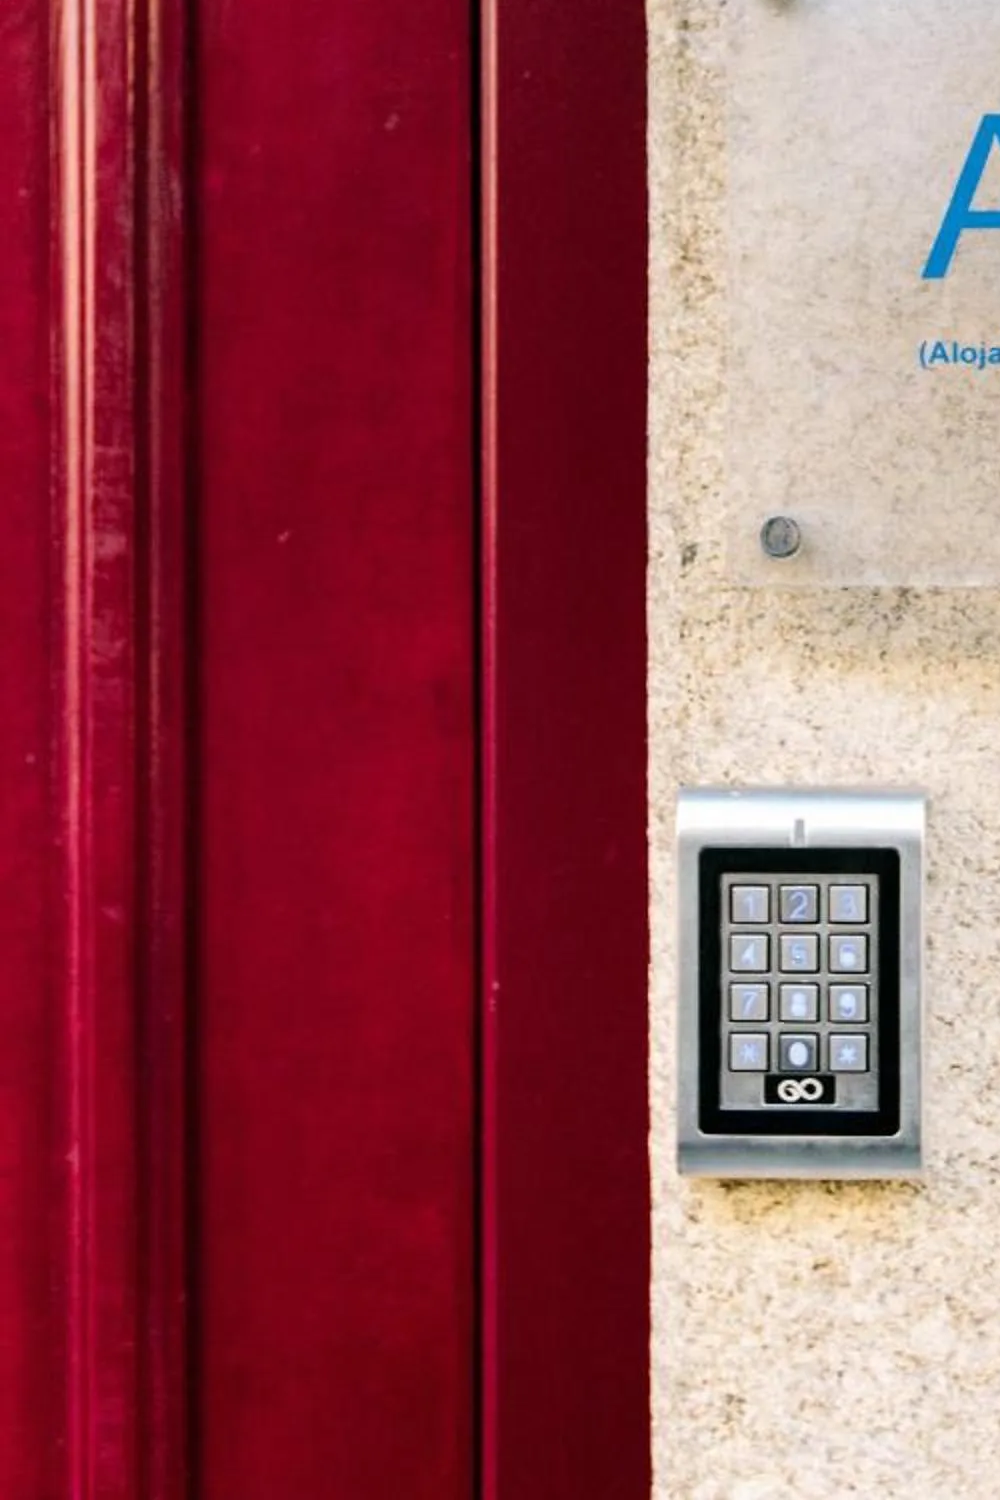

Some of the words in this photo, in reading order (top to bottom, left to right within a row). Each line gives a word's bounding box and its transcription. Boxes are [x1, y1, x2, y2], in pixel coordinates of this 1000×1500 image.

[789, 891, 808, 919] 2
[840, 892, 857, 918] 3
[839, 943, 856, 968] 6
[742, 991, 758, 1017] 7
[790, 992, 806, 1017] 8
[839, 992, 856, 1018] 9
